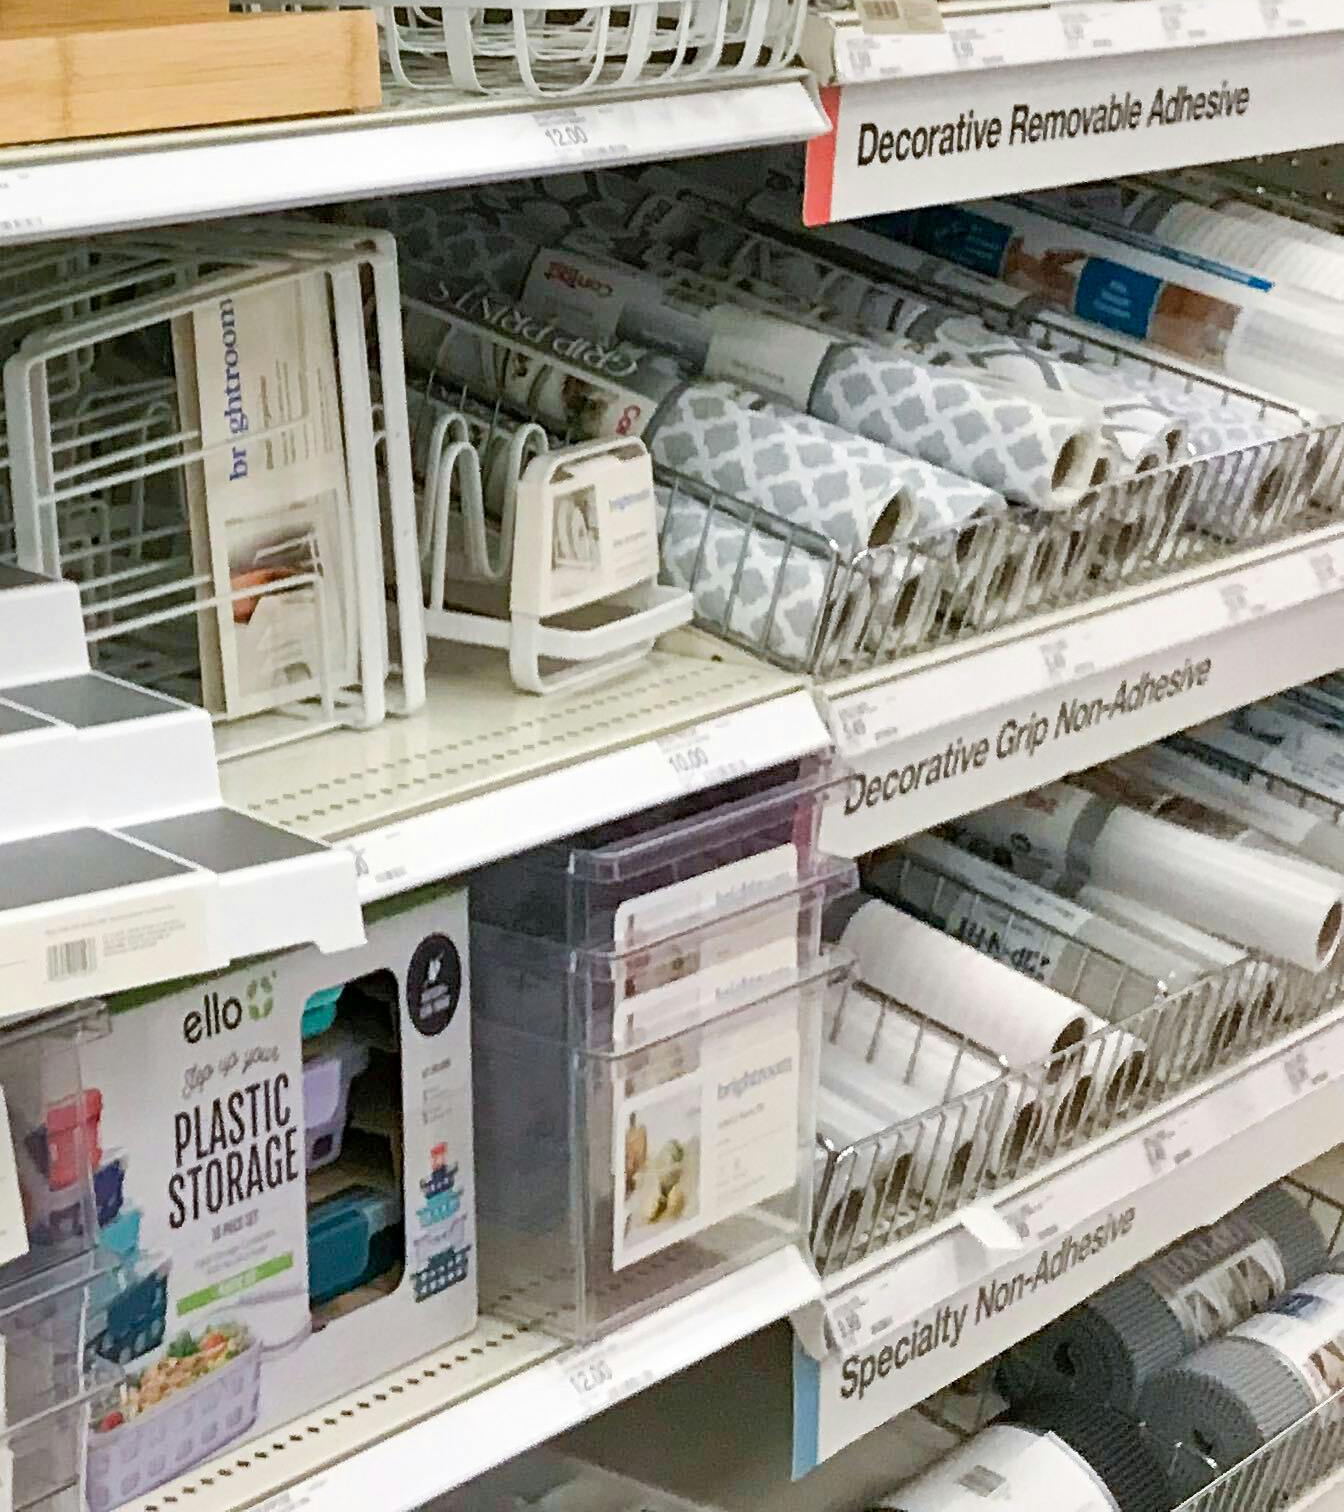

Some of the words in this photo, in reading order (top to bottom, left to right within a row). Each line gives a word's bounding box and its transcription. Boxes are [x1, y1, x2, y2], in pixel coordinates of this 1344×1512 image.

[857, 108, 1002, 167] Decorative
[1009, 89, 1142, 145] Removable
[1146, 80, 1251, 128] Adhesive
[219, 297, 250, 482] brghtroom
[844, 735, 990, 816] Decorative
[995, 711, 1050, 759] Grip
[1053, 656, 1213, 740] Non-Adhesive
[182, 991, 243, 1045] ello
[174, 1072, 292, 1169] PLASTIC
[168, 1125, 299, 1230] STORAGE
[839, 1303, 969, 1400] Specialty
[974, 1206, 1137, 1326] Non-Adhesive
